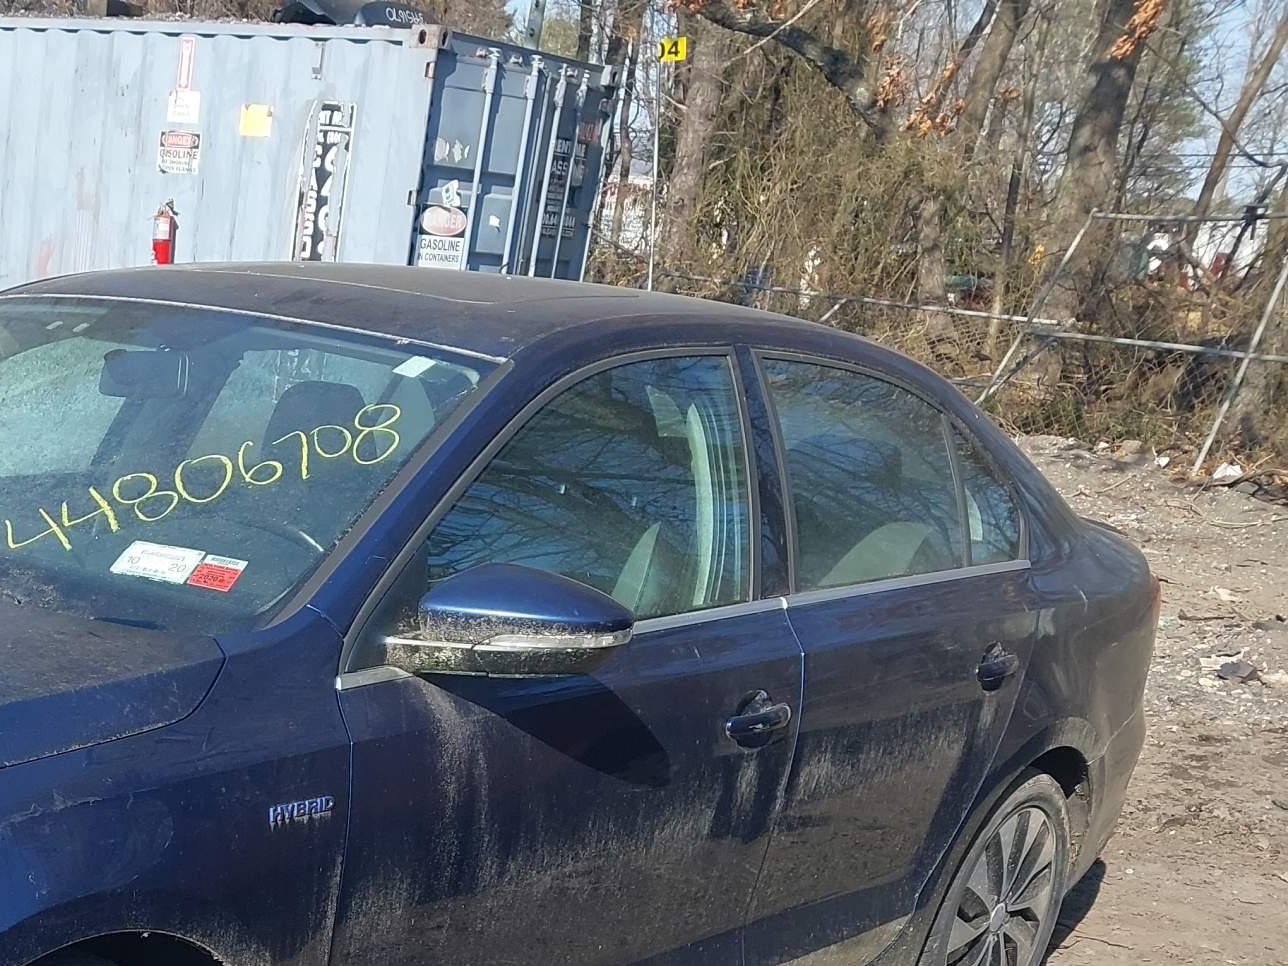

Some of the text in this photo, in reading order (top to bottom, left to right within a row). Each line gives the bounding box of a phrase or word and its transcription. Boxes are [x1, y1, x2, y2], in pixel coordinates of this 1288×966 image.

[420, 238, 461, 252] GASOLINE
[424, 252, 460, 263] CONTAINERS
[5, 404, 401, 551] 44806708
[168, 563, 187, 573] 20
[269, 797, 334, 822] HYBRID
